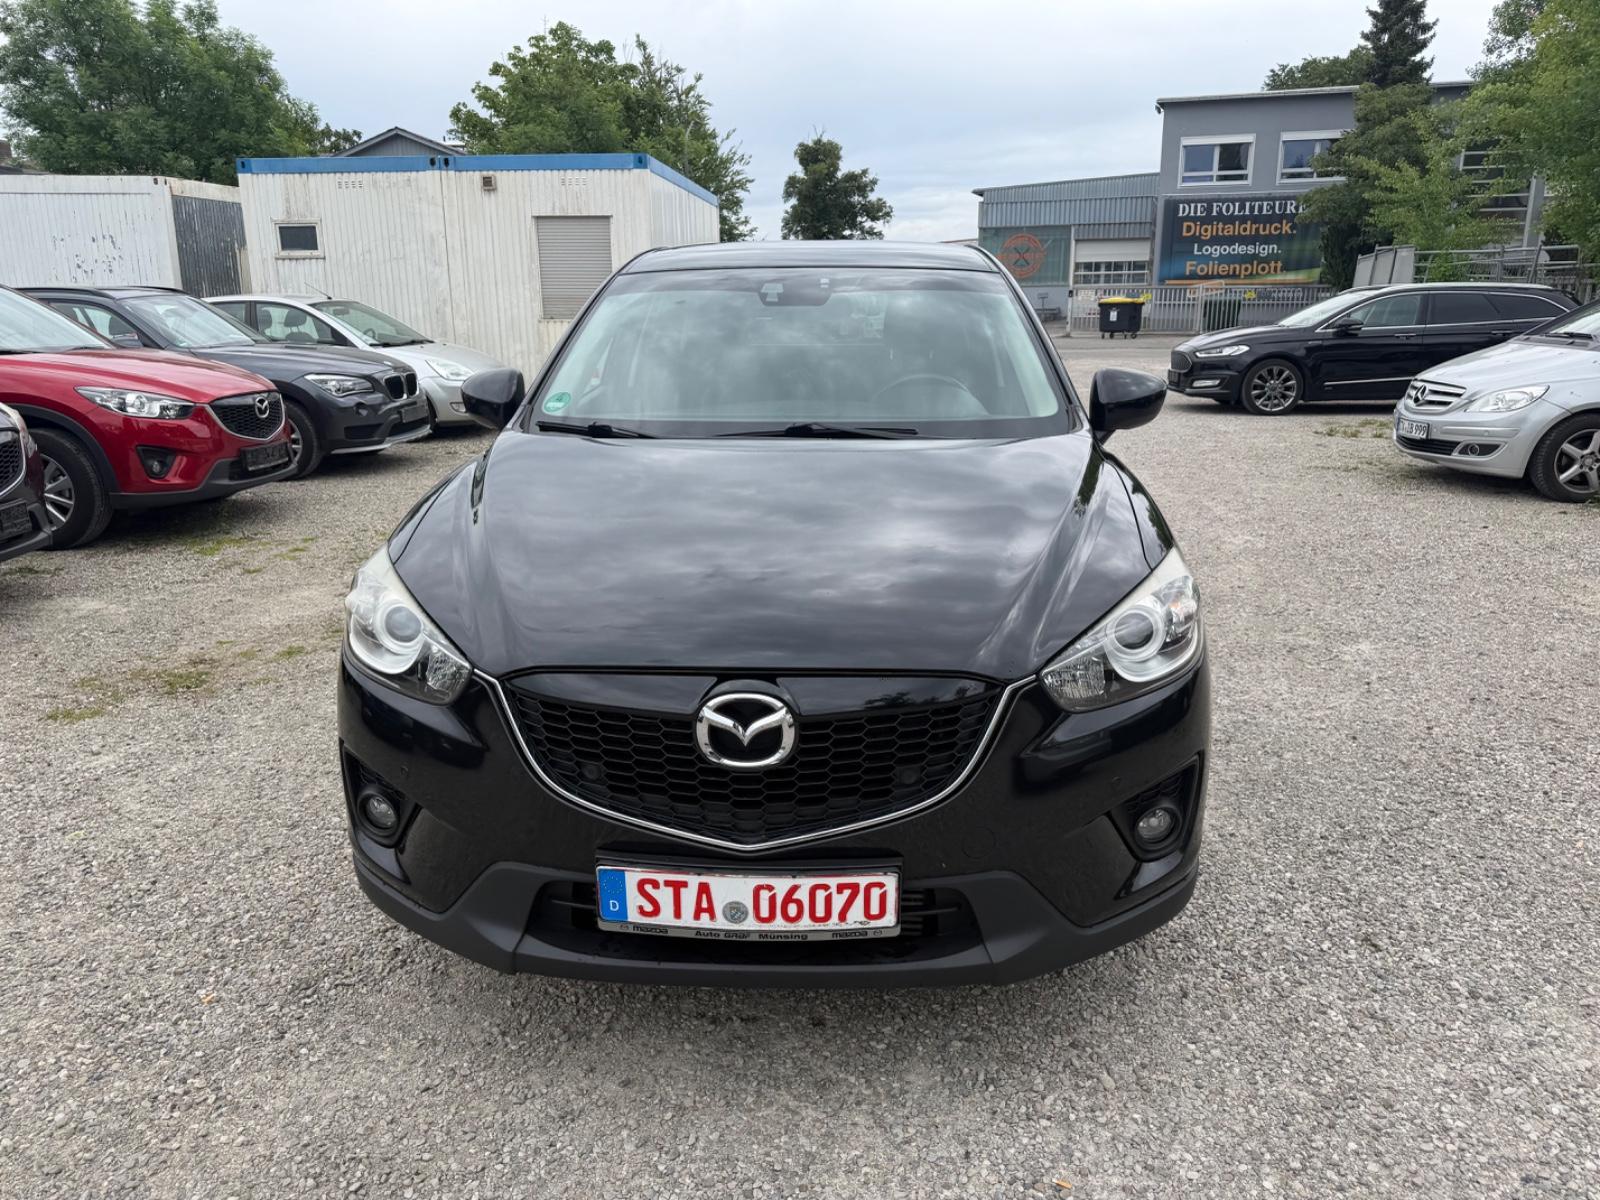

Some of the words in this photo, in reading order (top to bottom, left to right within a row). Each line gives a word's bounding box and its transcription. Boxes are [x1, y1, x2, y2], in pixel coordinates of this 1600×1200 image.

[1177, 202, 1207, 217] DIE
[1182, 219, 1297, 240] Digitaldruck.
[1193, 242, 1281, 258] Logodesign.
[1185, 260, 1287, 279] Folienplott.
[609, 900, 618, 912] D
[636, 878, 717, 922] STA
[752, 881, 888, 924] 06070
